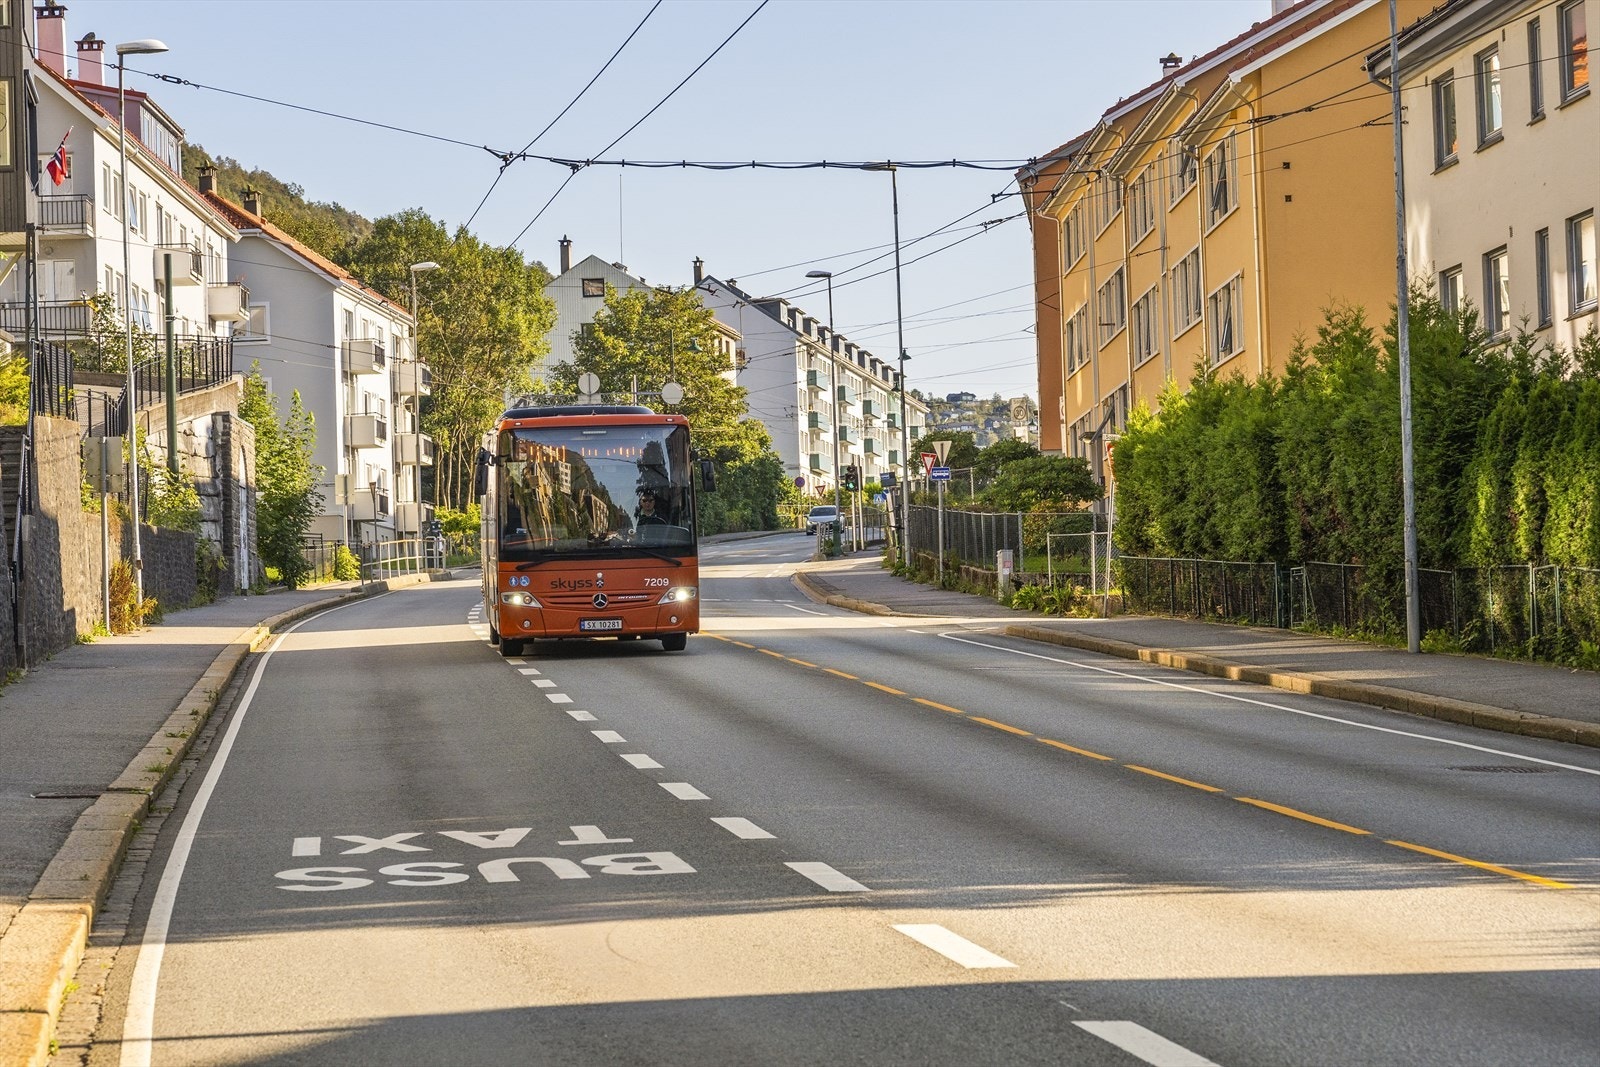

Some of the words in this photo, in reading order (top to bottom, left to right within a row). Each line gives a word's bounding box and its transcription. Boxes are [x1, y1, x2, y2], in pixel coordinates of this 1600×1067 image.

[550, 578, 593, 591] skyss
[644, 578, 670, 587] 7209
[292, 825, 634, 857] TAXI
[274, 851, 698, 892] BUSS
